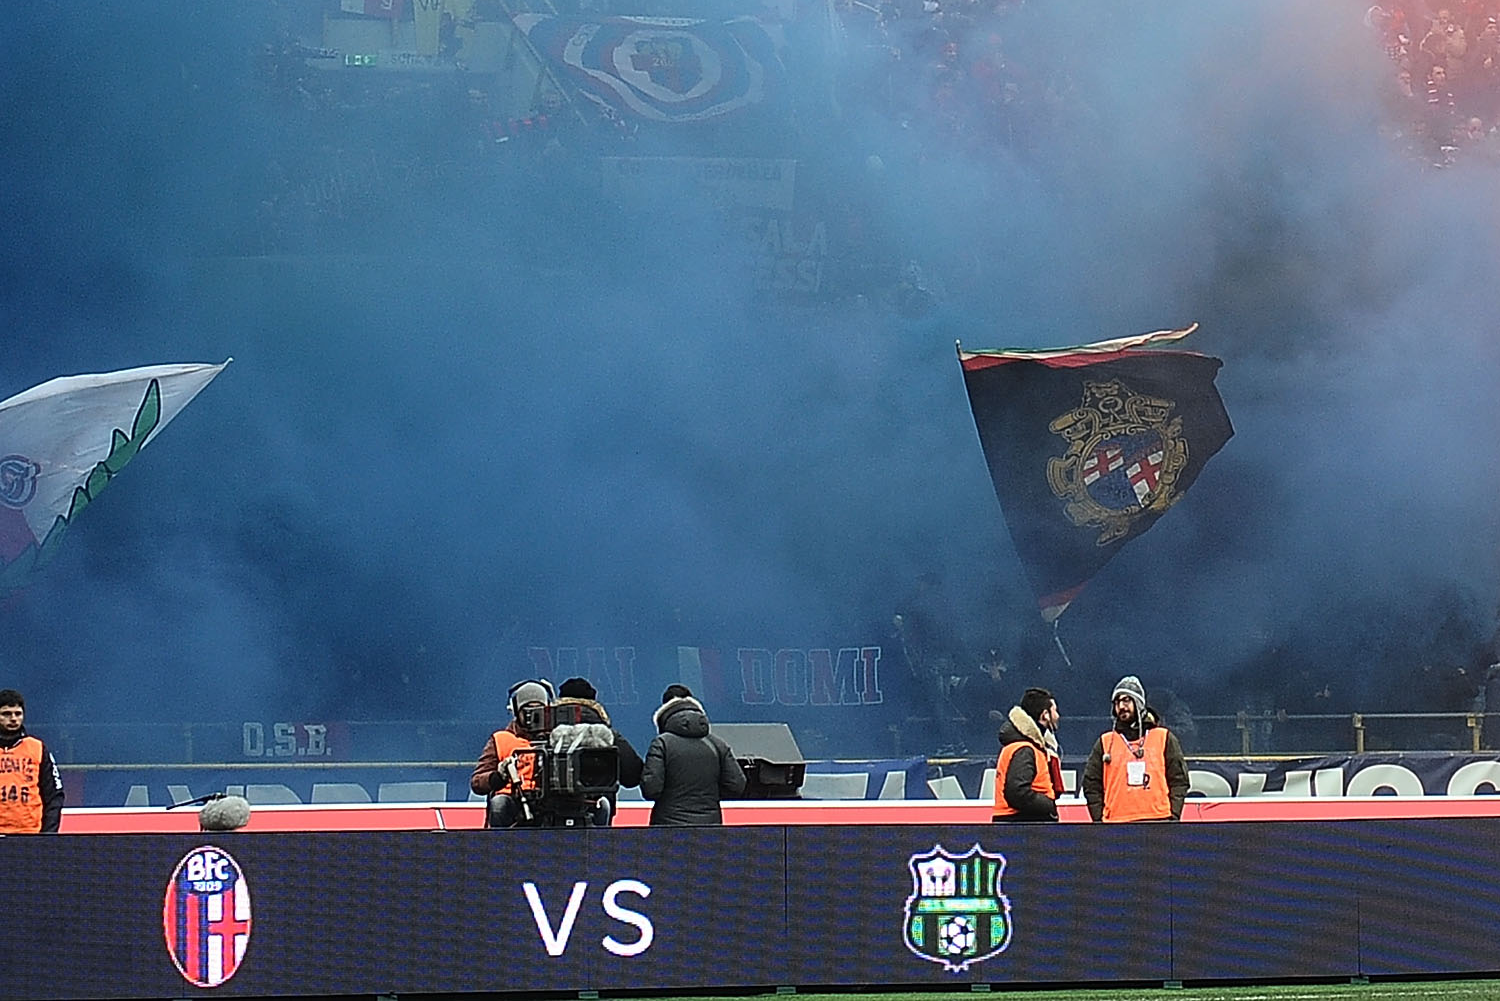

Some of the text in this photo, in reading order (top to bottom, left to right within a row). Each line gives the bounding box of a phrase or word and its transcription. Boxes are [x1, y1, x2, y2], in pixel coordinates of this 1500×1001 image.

[737, 646, 884, 707] DOMI
[243, 721, 332, 758] O.S.B.
[522, 879, 654, 958] VS
